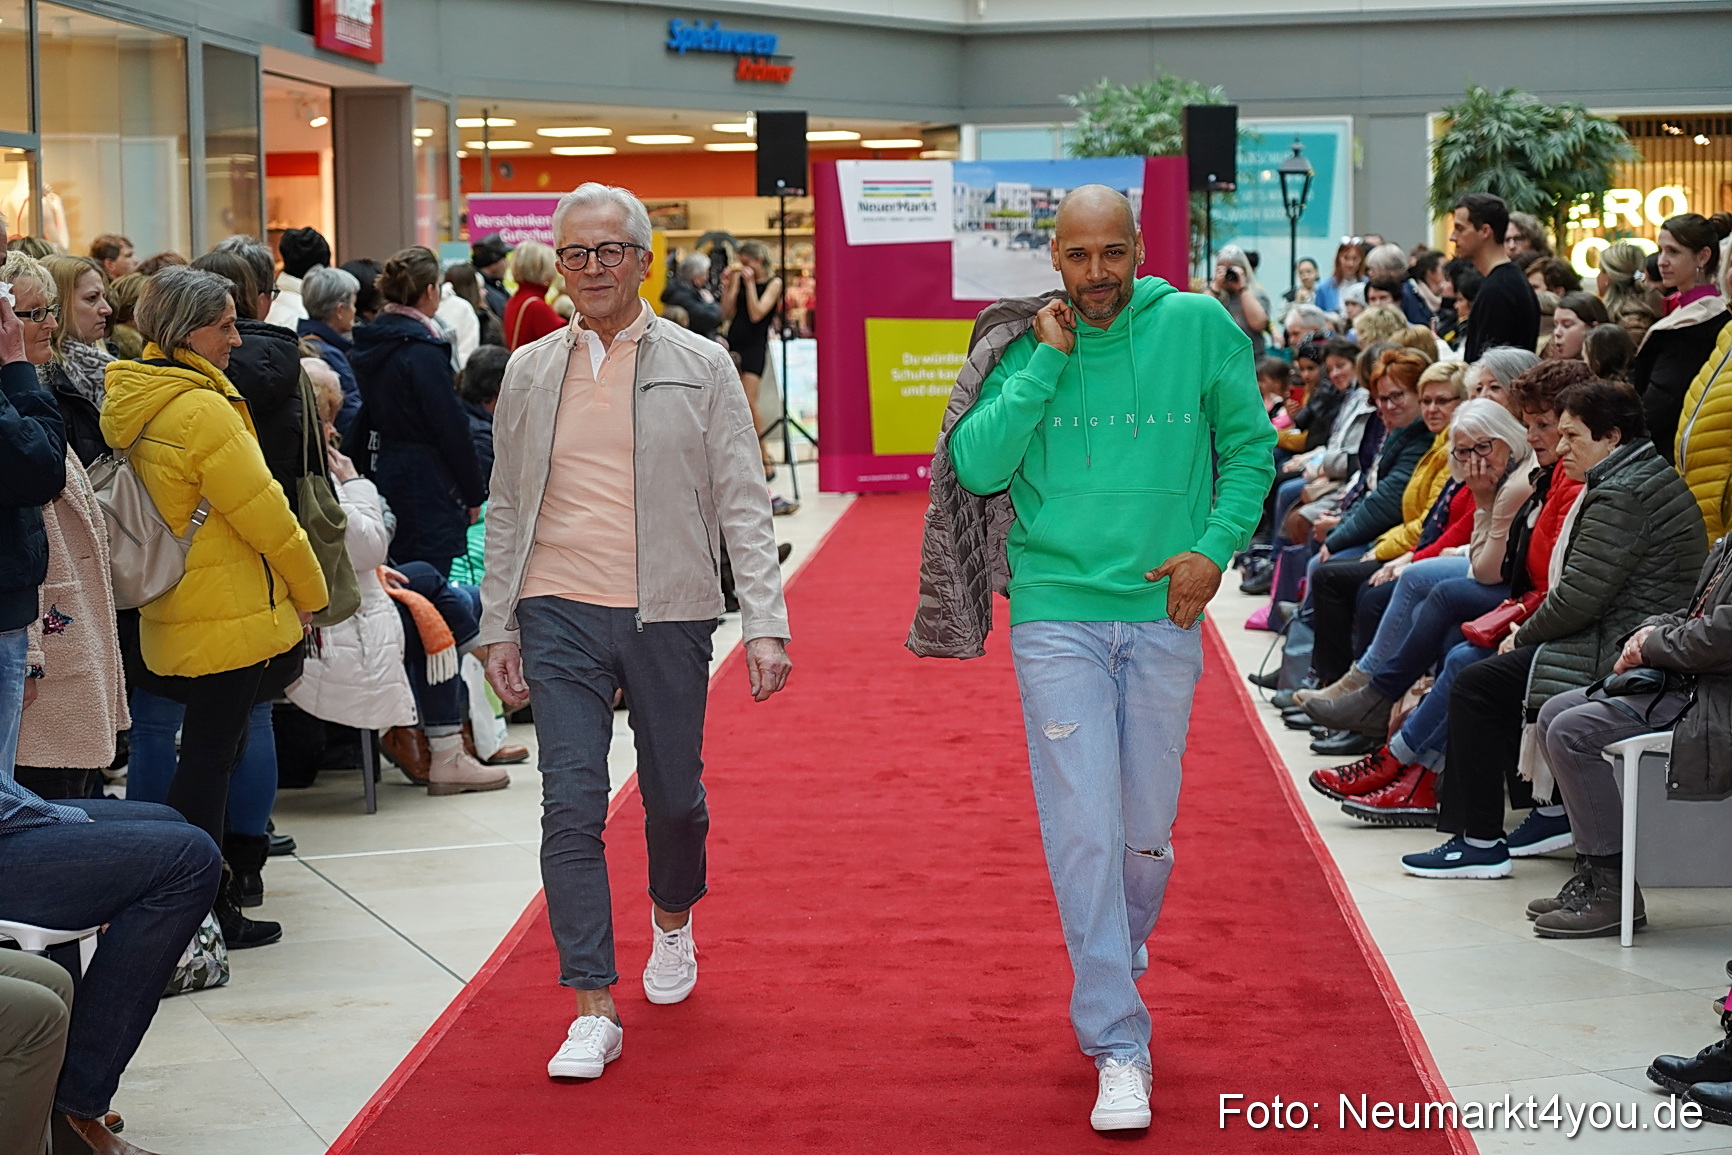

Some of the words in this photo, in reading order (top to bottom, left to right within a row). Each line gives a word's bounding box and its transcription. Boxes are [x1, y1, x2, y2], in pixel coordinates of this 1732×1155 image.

[667, 18, 778, 54] Spielwaren
[857, 201, 937, 213] NeuerMarkt
[473, 213, 553, 228] Verschenken
[901, 352, 920, 366] Du
[890, 368, 935, 381] Schuhe
[901, 385, 926, 398] und
[1053, 412, 1191, 427] RIGINALS
